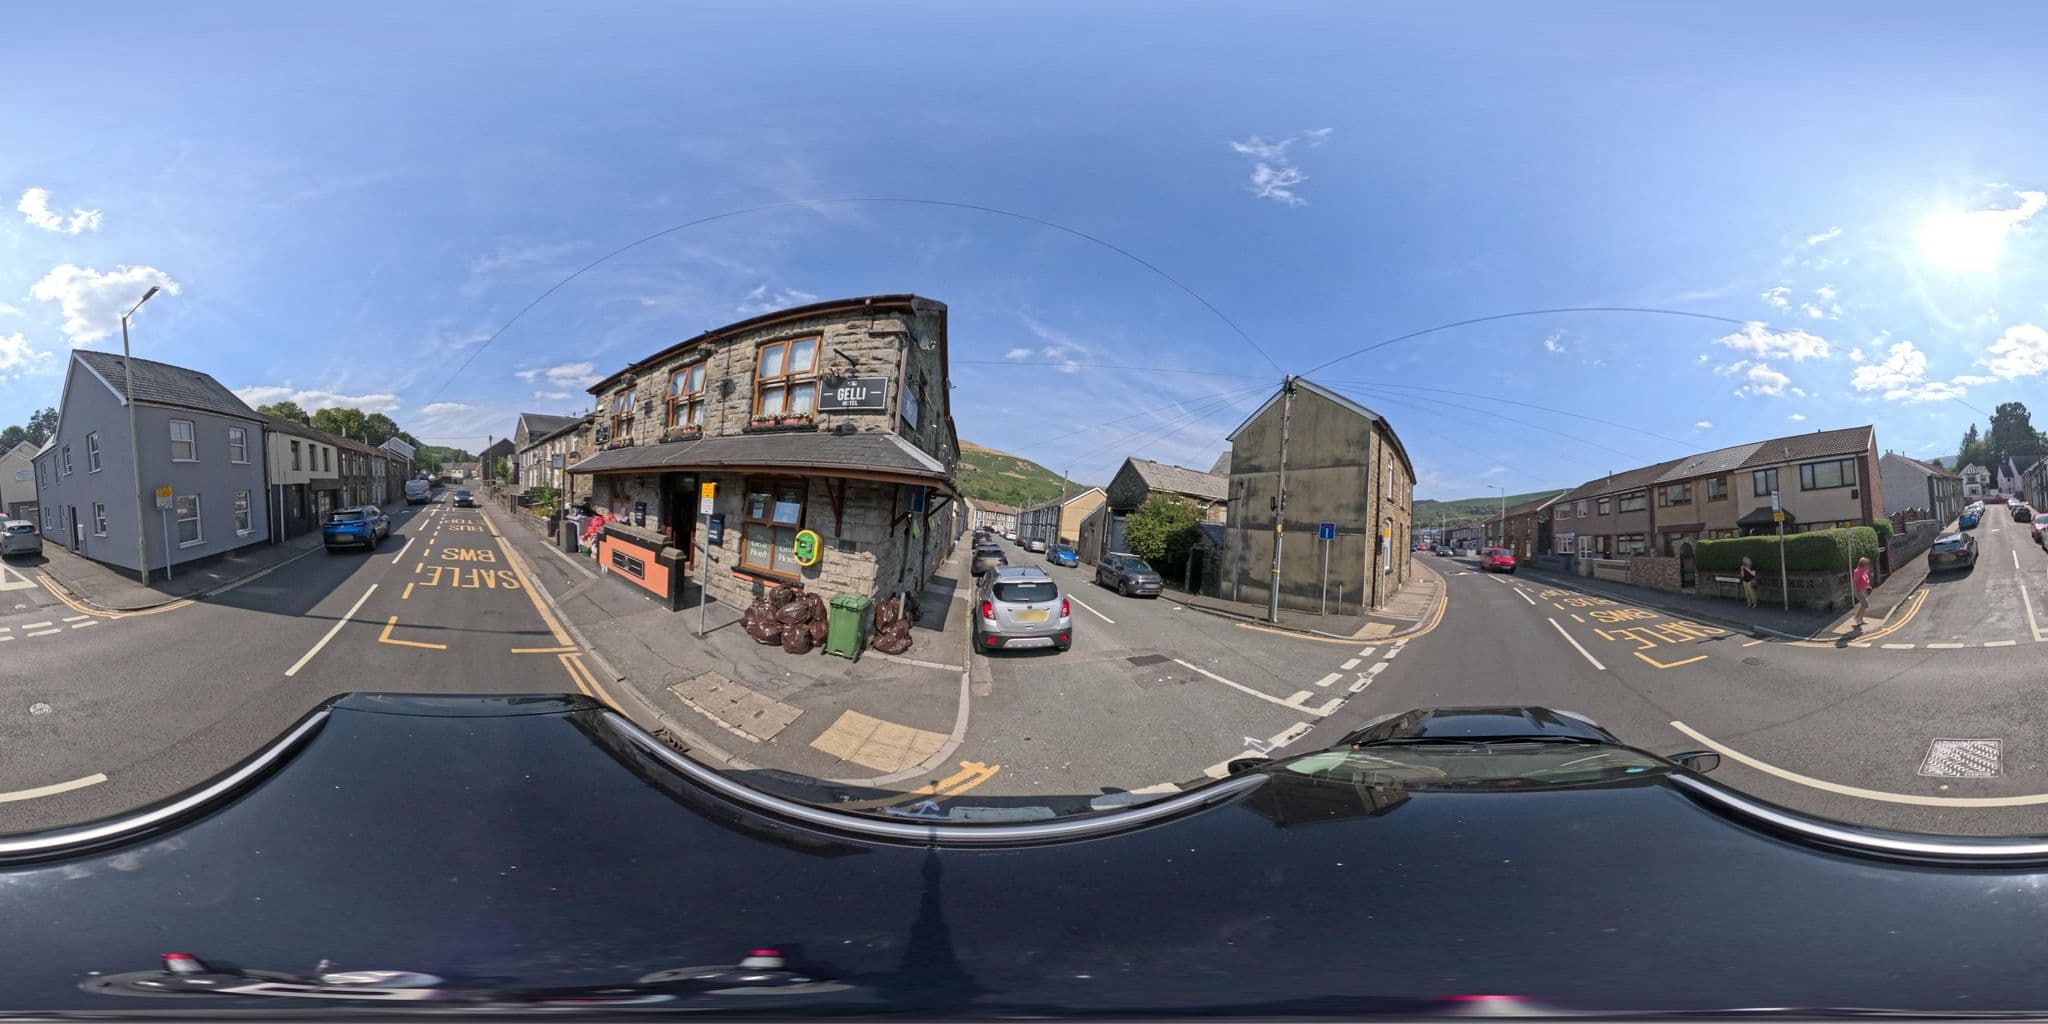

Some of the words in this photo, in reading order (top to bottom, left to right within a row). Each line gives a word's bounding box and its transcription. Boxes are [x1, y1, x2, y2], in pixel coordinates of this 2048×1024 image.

[837, 387, 866, 401] GELLI
[441, 548, 496, 562] BWS
[419, 565, 520, 589] SAFLE
[1589, 608, 1660, 623] BWS
[1608, 621, 1725, 649] SAFLE
